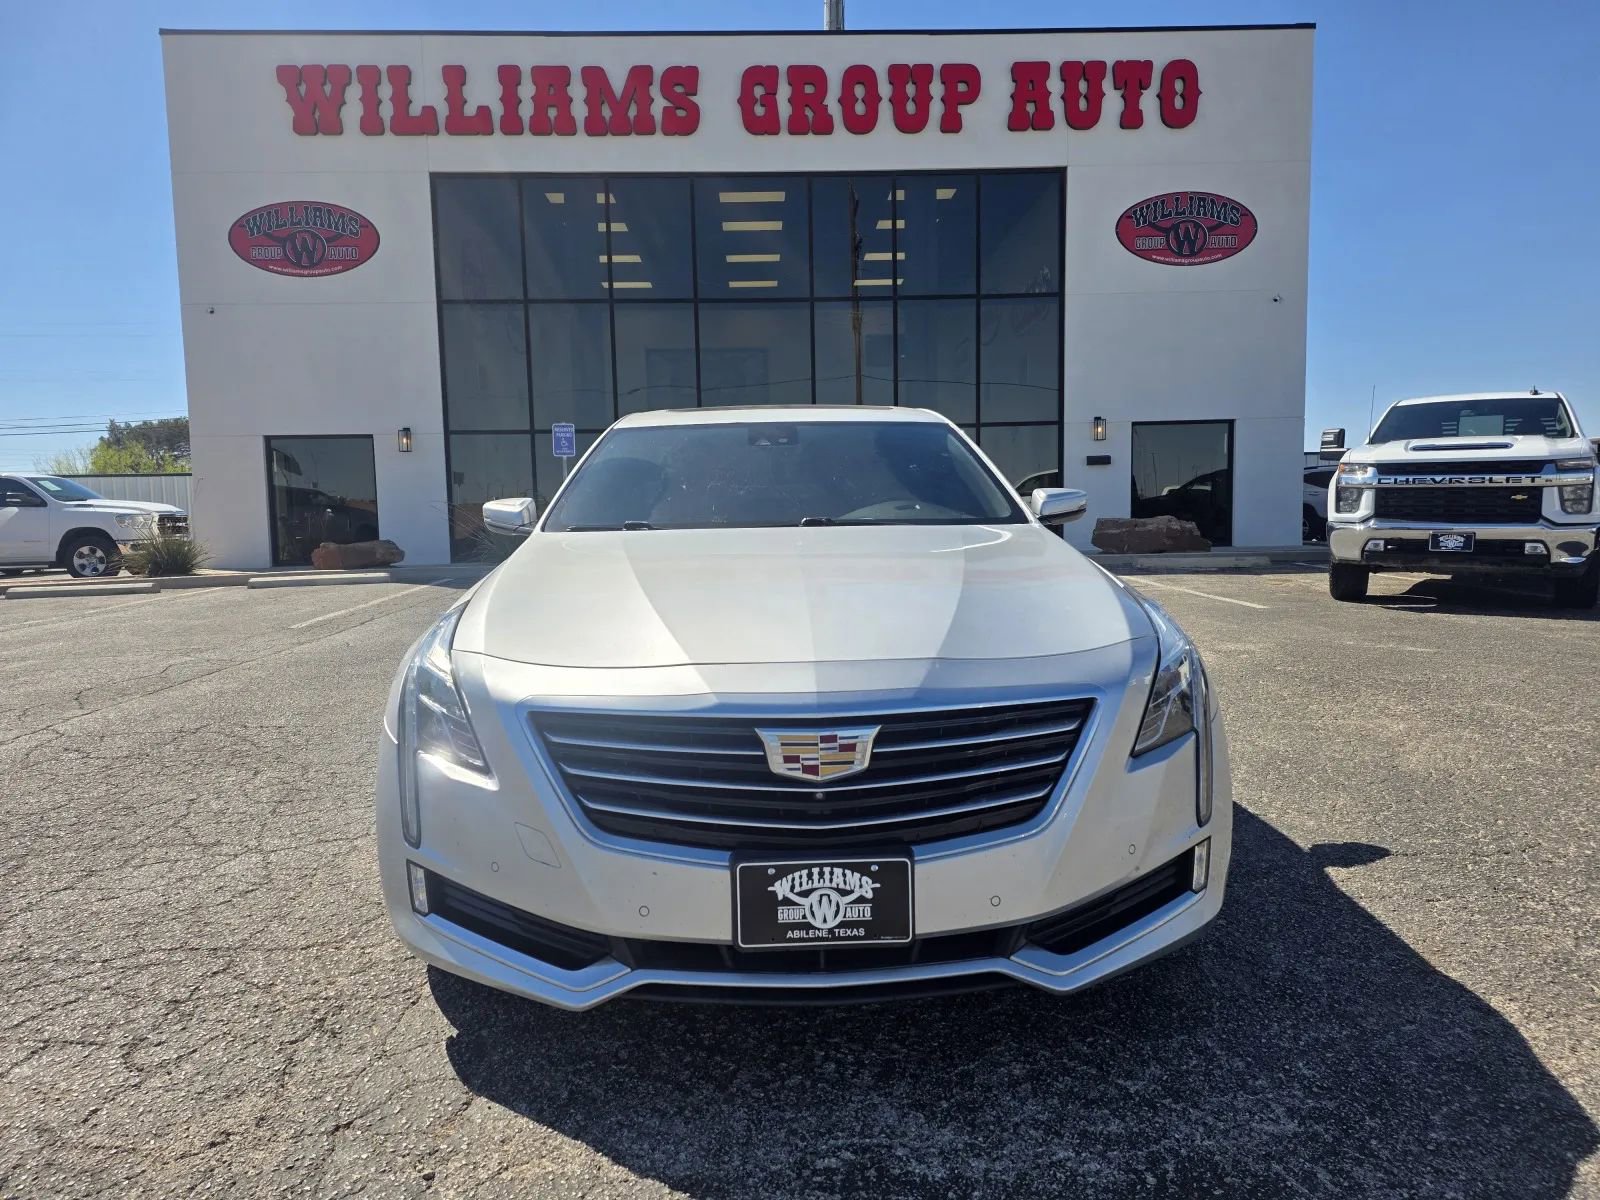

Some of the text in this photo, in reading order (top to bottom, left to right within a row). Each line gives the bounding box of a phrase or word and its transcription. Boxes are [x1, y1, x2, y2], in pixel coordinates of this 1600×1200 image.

[275, 59, 1203, 137] WILLIAMS GROUP AUTO
[1132, 195, 1241, 228] WILLIAMS
[244, 205, 361, 238] WILLIAMS
[1135, 235, 1238, 250] GROUP AUTO
[251, 246, 359, 260] GROUP AUTO
[1151, 253, 1223, 264] www.williamsgroupauto.com
[1377, 476, 1542, 485] CHEVROLET
[773, 866, 874, 901] WILLIAMS
[777, 905, 872, 921] GROUP AUTO
[786, 927, 865, 939] ABILENE, TEXAS
